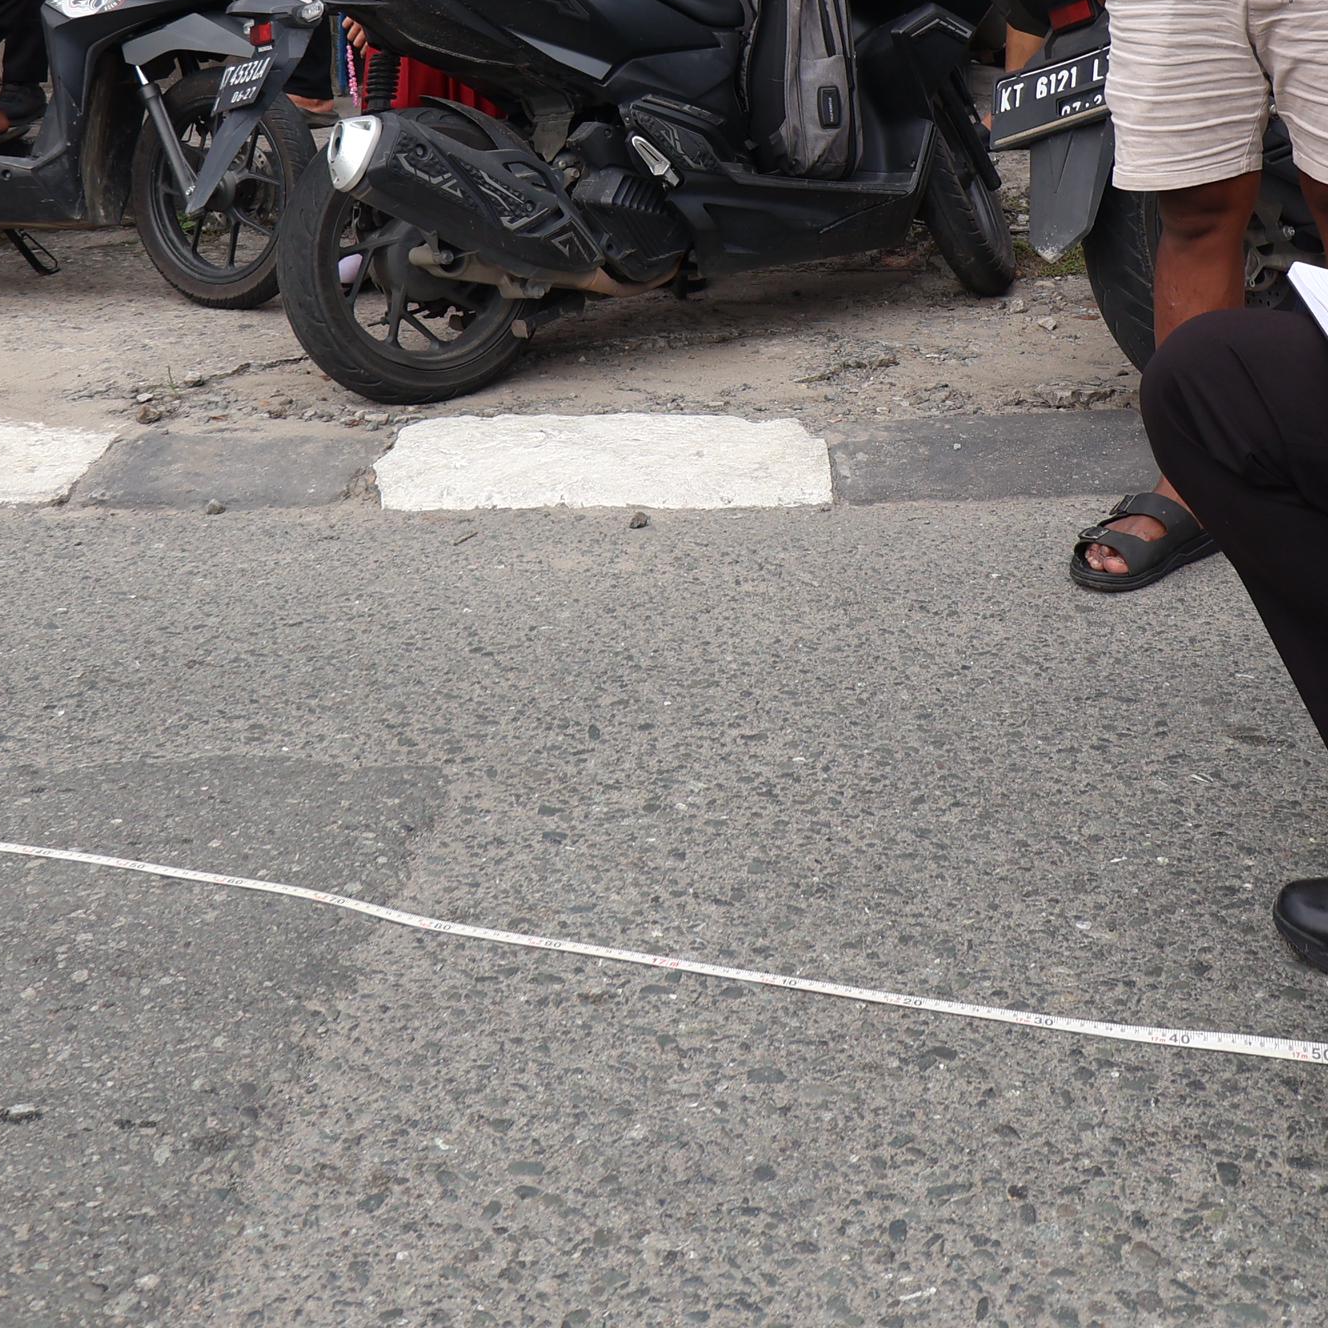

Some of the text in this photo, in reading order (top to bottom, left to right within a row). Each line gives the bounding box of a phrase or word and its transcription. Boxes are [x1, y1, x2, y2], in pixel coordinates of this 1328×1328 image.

[1000, 54, 1110, 112] KT 6121 L
[1034, 1016, 1053, 1026] 30
[1169, 1034, 1191, 1045] 40
[1292, 1051, 1308, 1059] 17m
